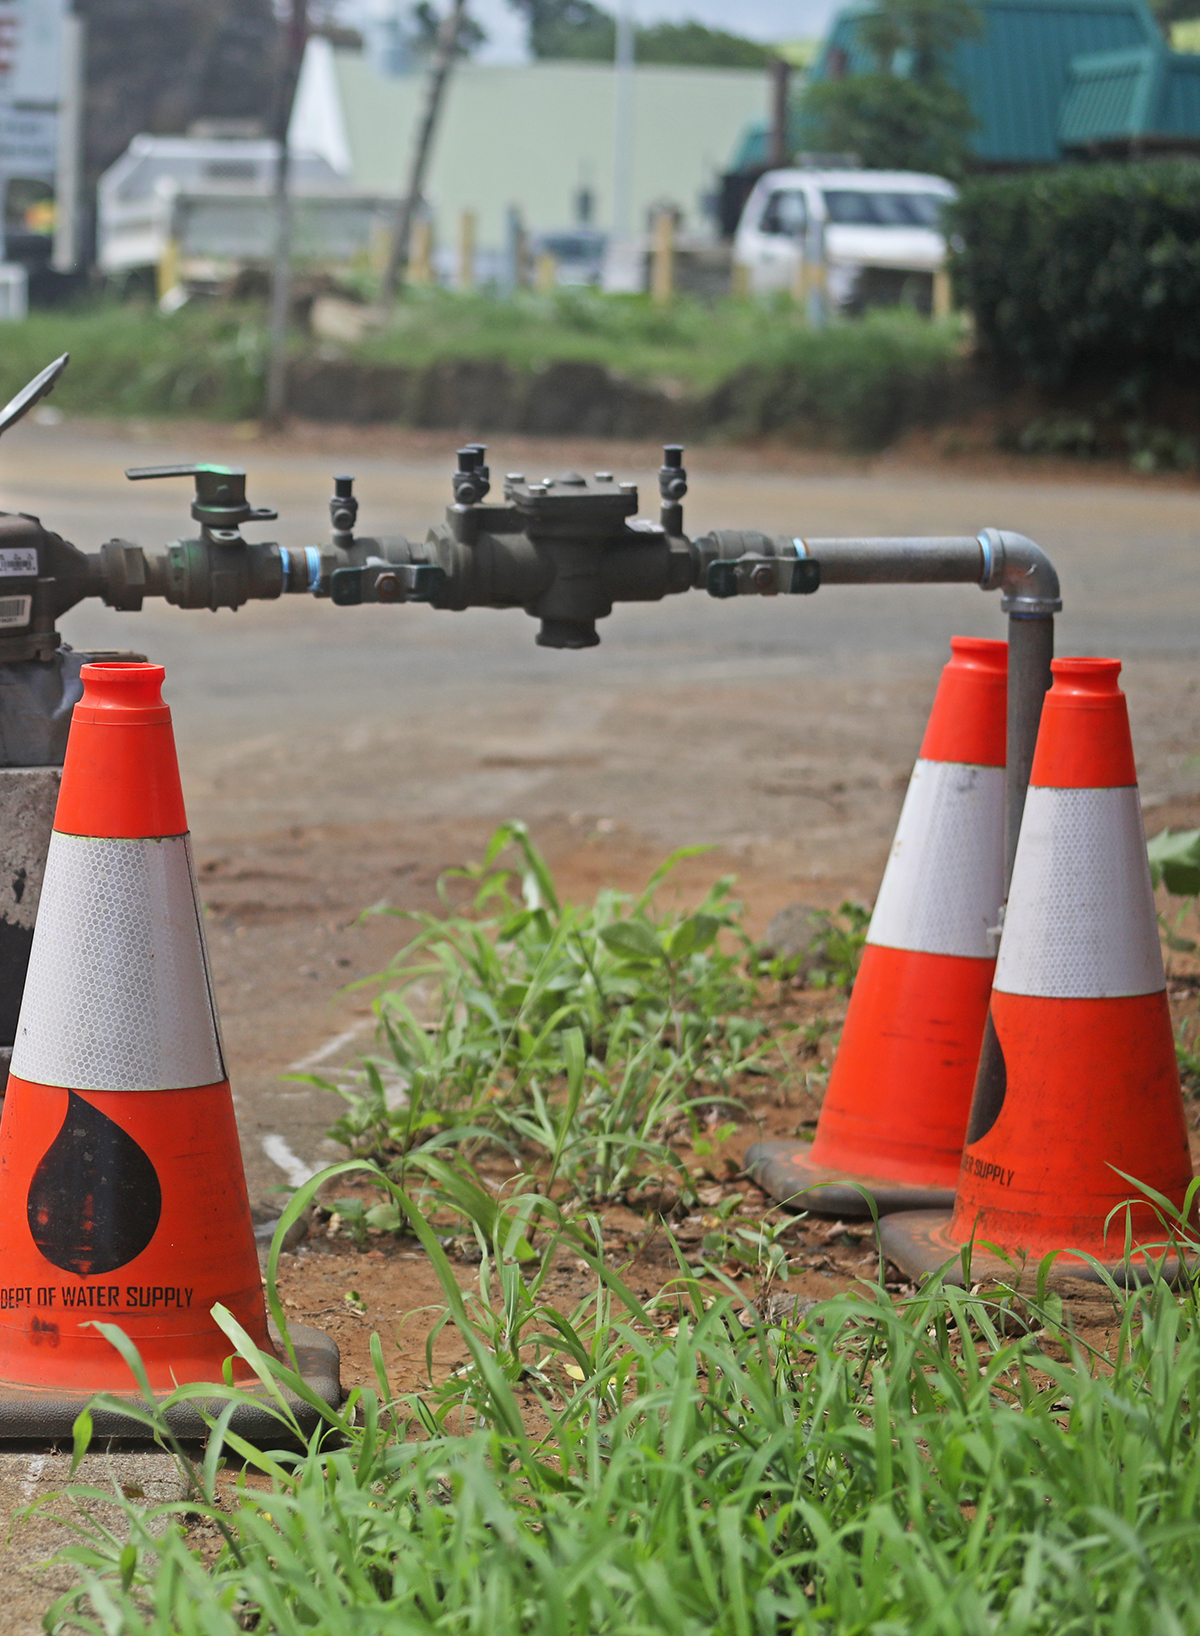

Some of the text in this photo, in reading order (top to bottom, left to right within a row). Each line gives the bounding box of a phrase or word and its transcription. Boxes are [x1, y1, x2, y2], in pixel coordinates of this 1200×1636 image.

[974, 1159, 1015, 1187] SUPPLY
[0, 1286, 194, 1309] DEPT OF WATER SUPPLY
